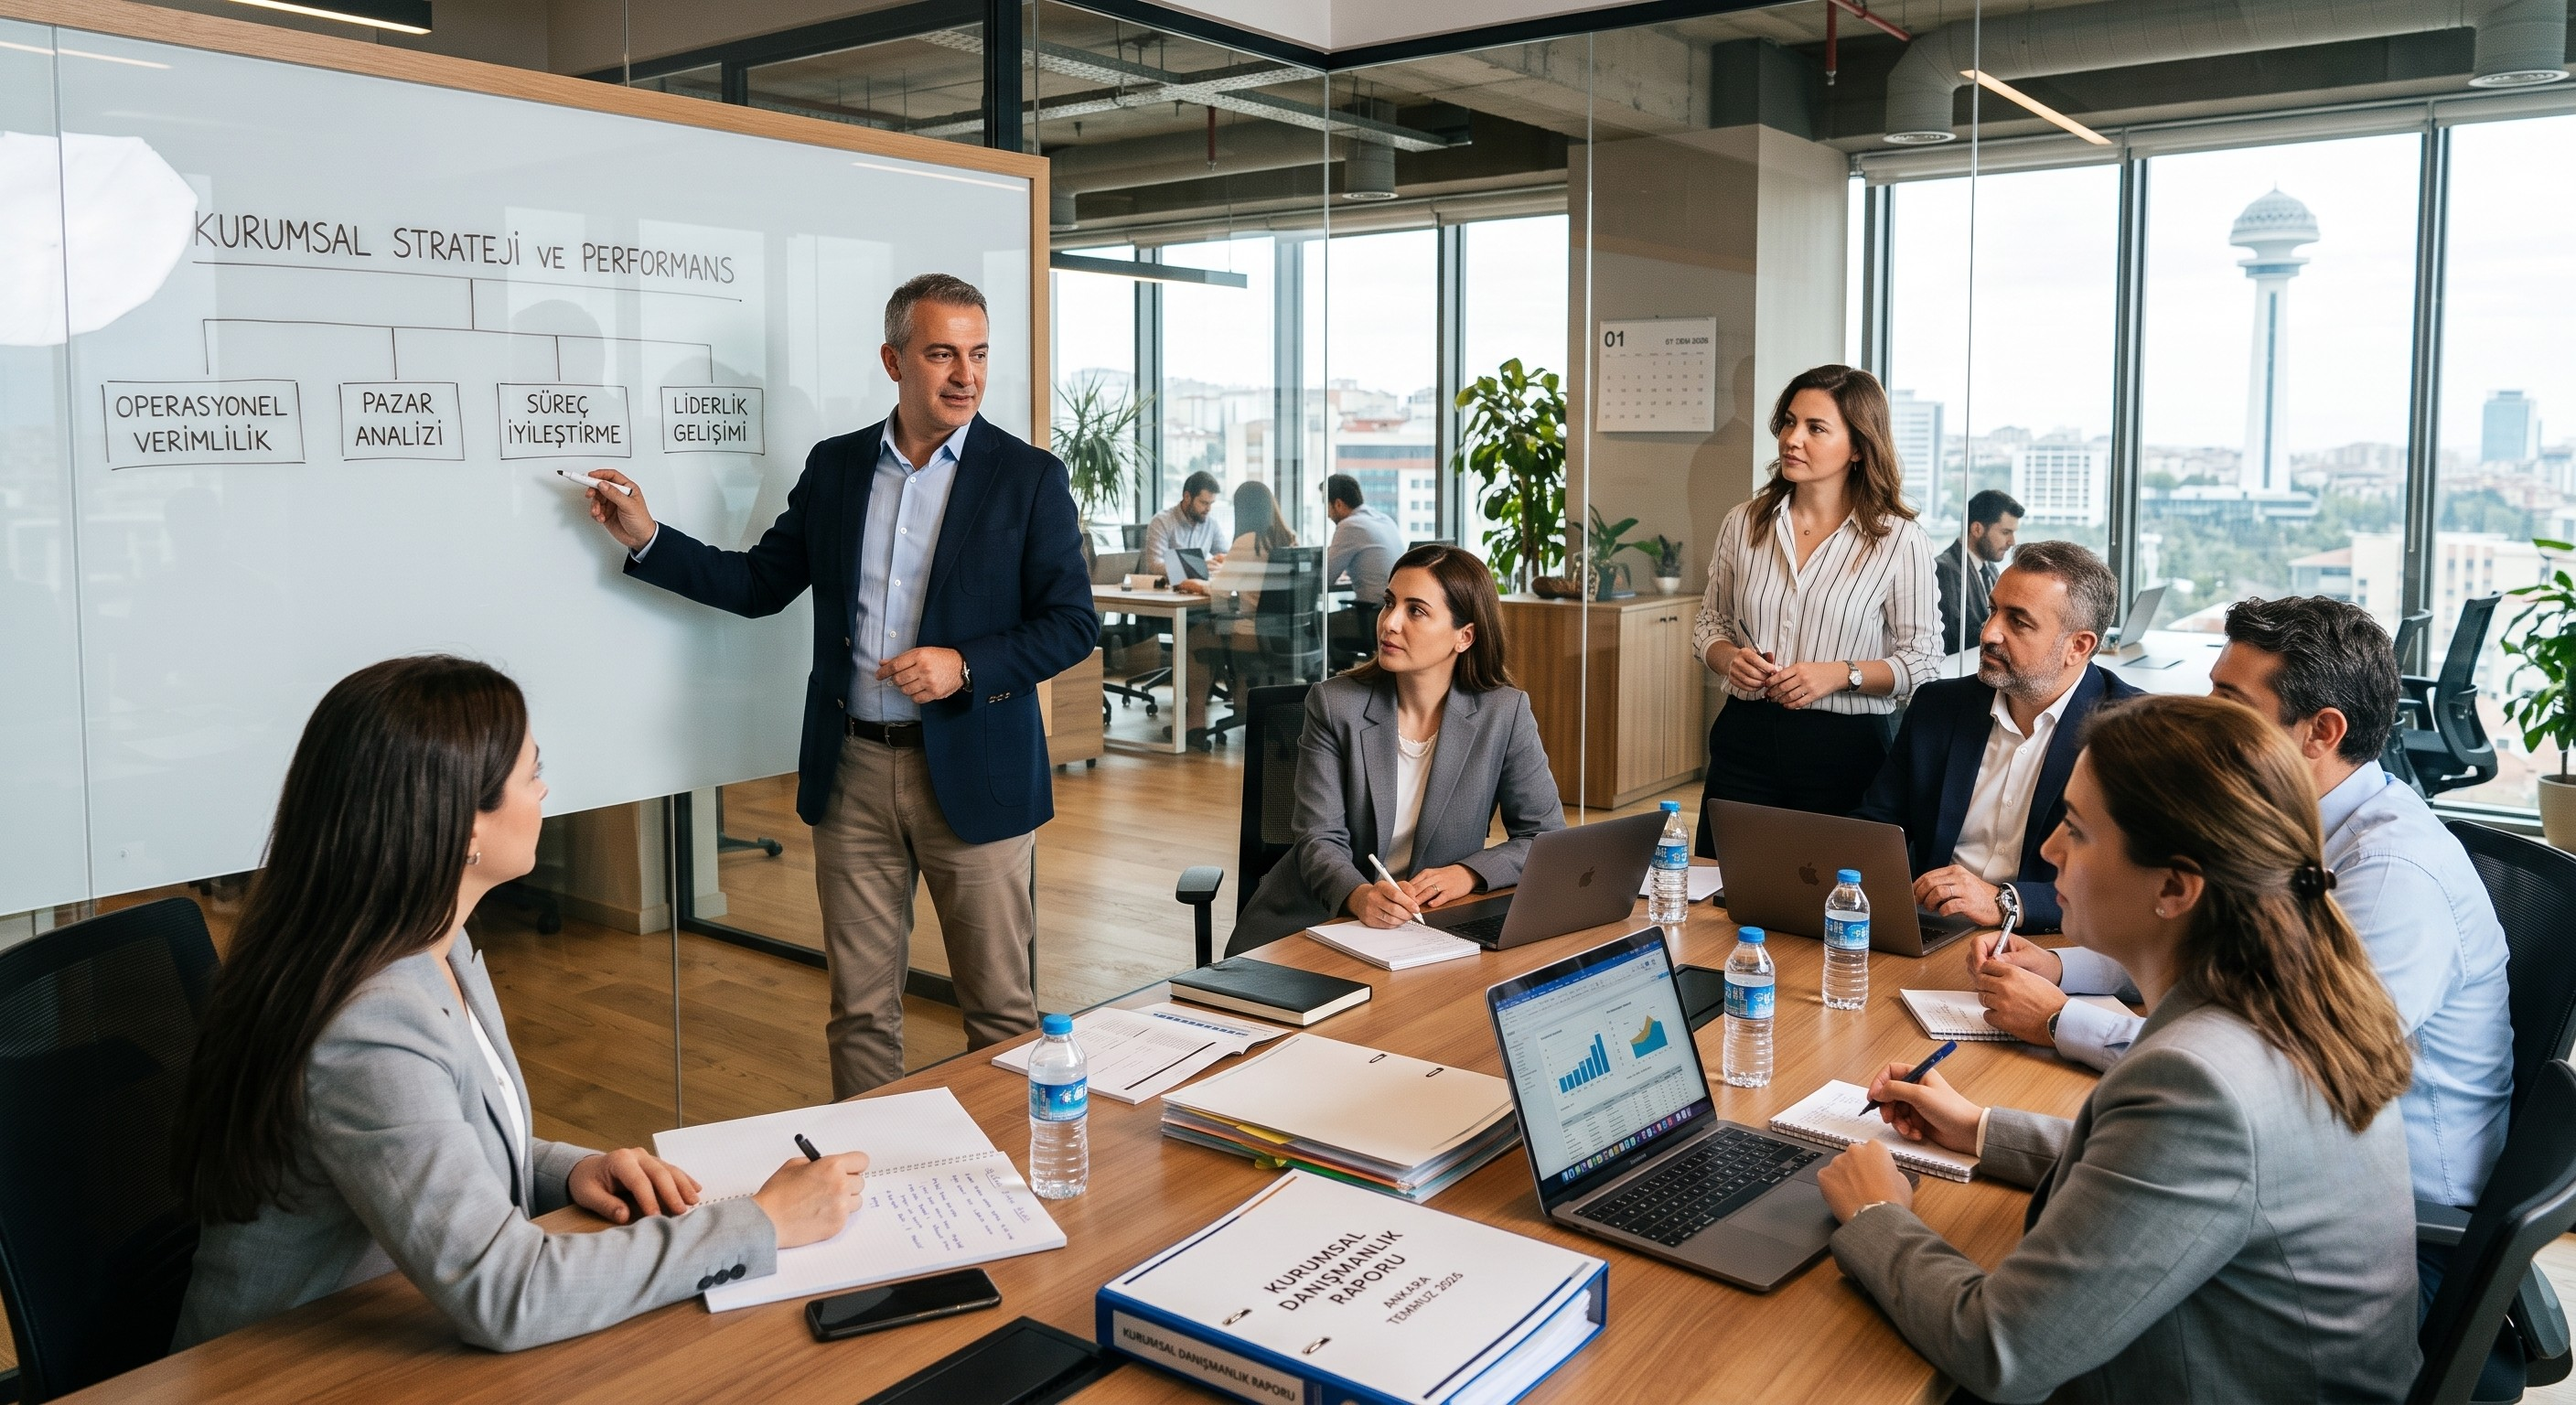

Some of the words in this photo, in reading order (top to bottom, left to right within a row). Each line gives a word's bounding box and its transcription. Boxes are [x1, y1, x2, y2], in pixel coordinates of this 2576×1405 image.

[195, 210, 371, 256] KURUMSAL
[393, 228, 519, 265] STRATEJİ
[537, 246, 565, 270] VE
[582, 242, 735, 284] PERFORMANS
[1605, 330, 1624, 348] 01
[116, 395, 287, 418] OPERASYONEL
[363, 391, 434, 414] PAZAR
[528, 390, 589, 417] SÜREÇ
[674, 392, 748, 415] LİDERLİK
[134, 424, 273, 453] VERİMLİLİK
[356, 419, 443, 446] ANALİZİ
[509, 419, 622, 448] İYİLEŞTİRME
[674, 420, 746, 445] GELİŞİMİ
[1263, 1233, 1367, 1293] KURUMSAL
[1279, 1230, 1403, 1311] DANIŞMANLIK
[1329, 1253, 1406, 1304] RAPORU
[1383, 1275, 1432, 1309] ANKARA
[1386, 1290, 1439, 1325] TEMMUZ
[1122, 1327, 1176, 1357] KURUMSAL
[1178, 1347, 1250, 1386] DANIŞMANLIK
[1251, 1378, 1295, 1402] RAPORU
